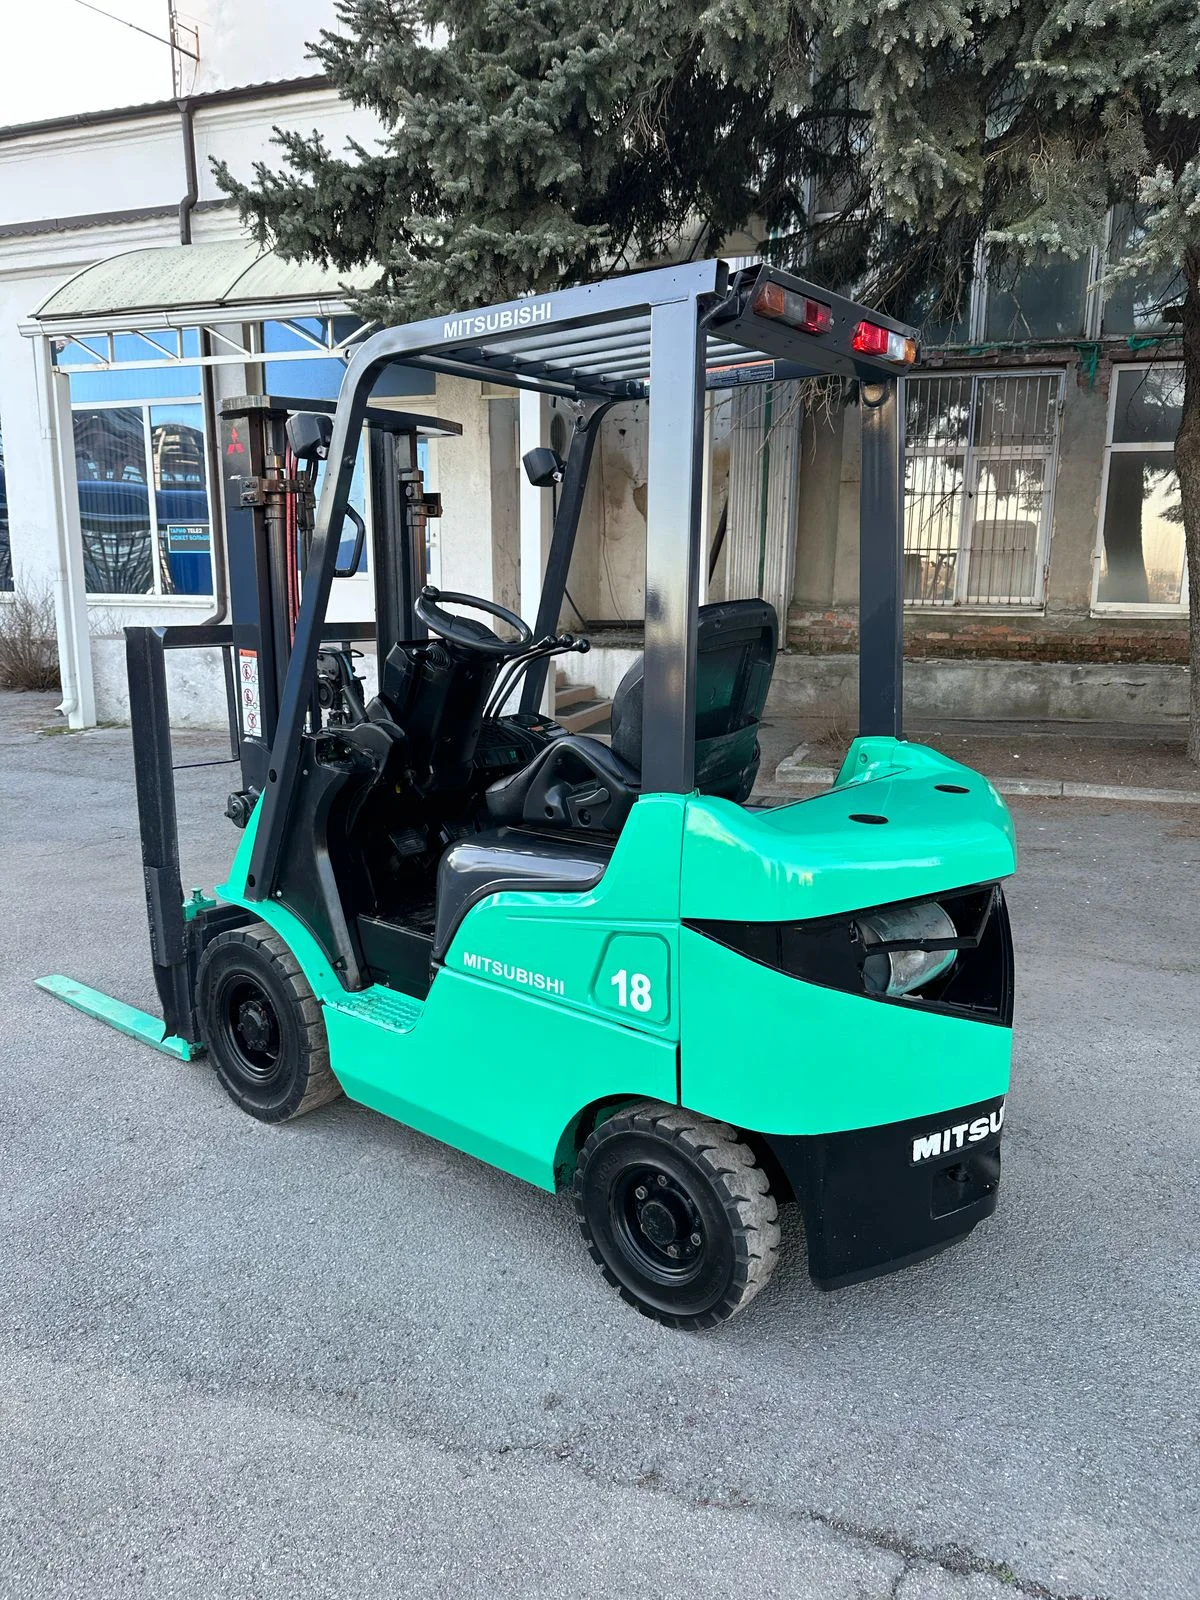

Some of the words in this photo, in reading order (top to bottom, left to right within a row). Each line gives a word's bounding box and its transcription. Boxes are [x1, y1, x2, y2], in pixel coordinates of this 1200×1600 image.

[443, 302, 552, 338] MITSUBISHI
[463, 951, 566, 996] MITSUBISHI
[610, 968, 653, 1013] 18
[912, 1099, 1005, 1163] MITSU
